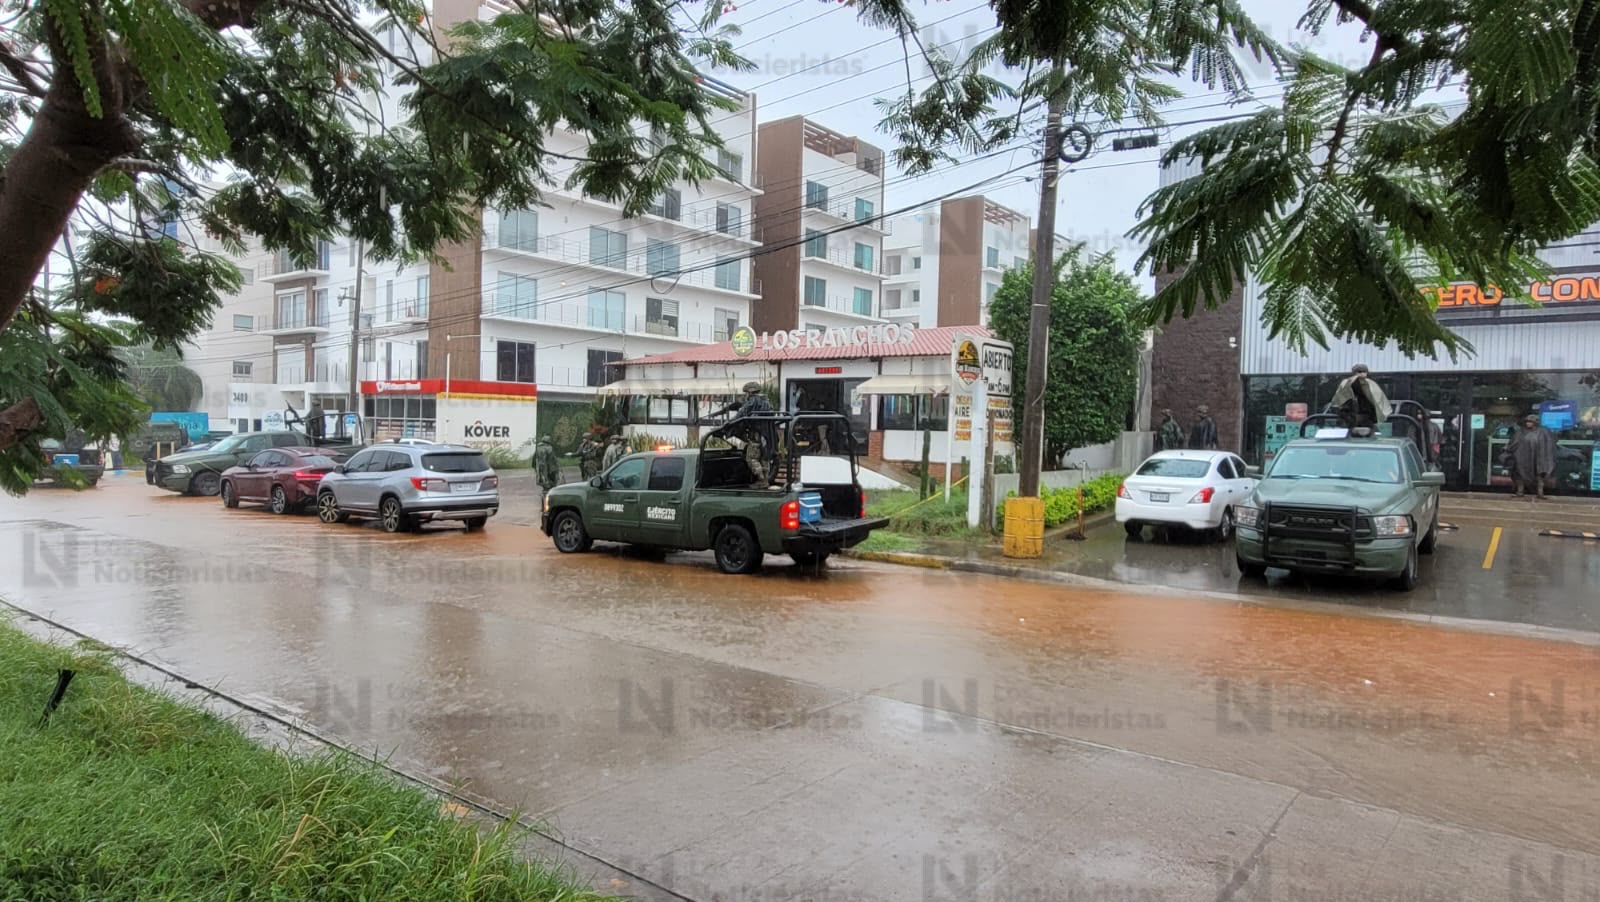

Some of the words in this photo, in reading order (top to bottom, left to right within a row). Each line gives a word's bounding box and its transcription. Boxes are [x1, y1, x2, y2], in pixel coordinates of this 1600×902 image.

[762, 329, 801, 350] LOS
[806, 322, 915, 348] RANCHOS
[983, 350, 1012, 372] ABIERTO
[954, 406, 971, 418] AIRE
